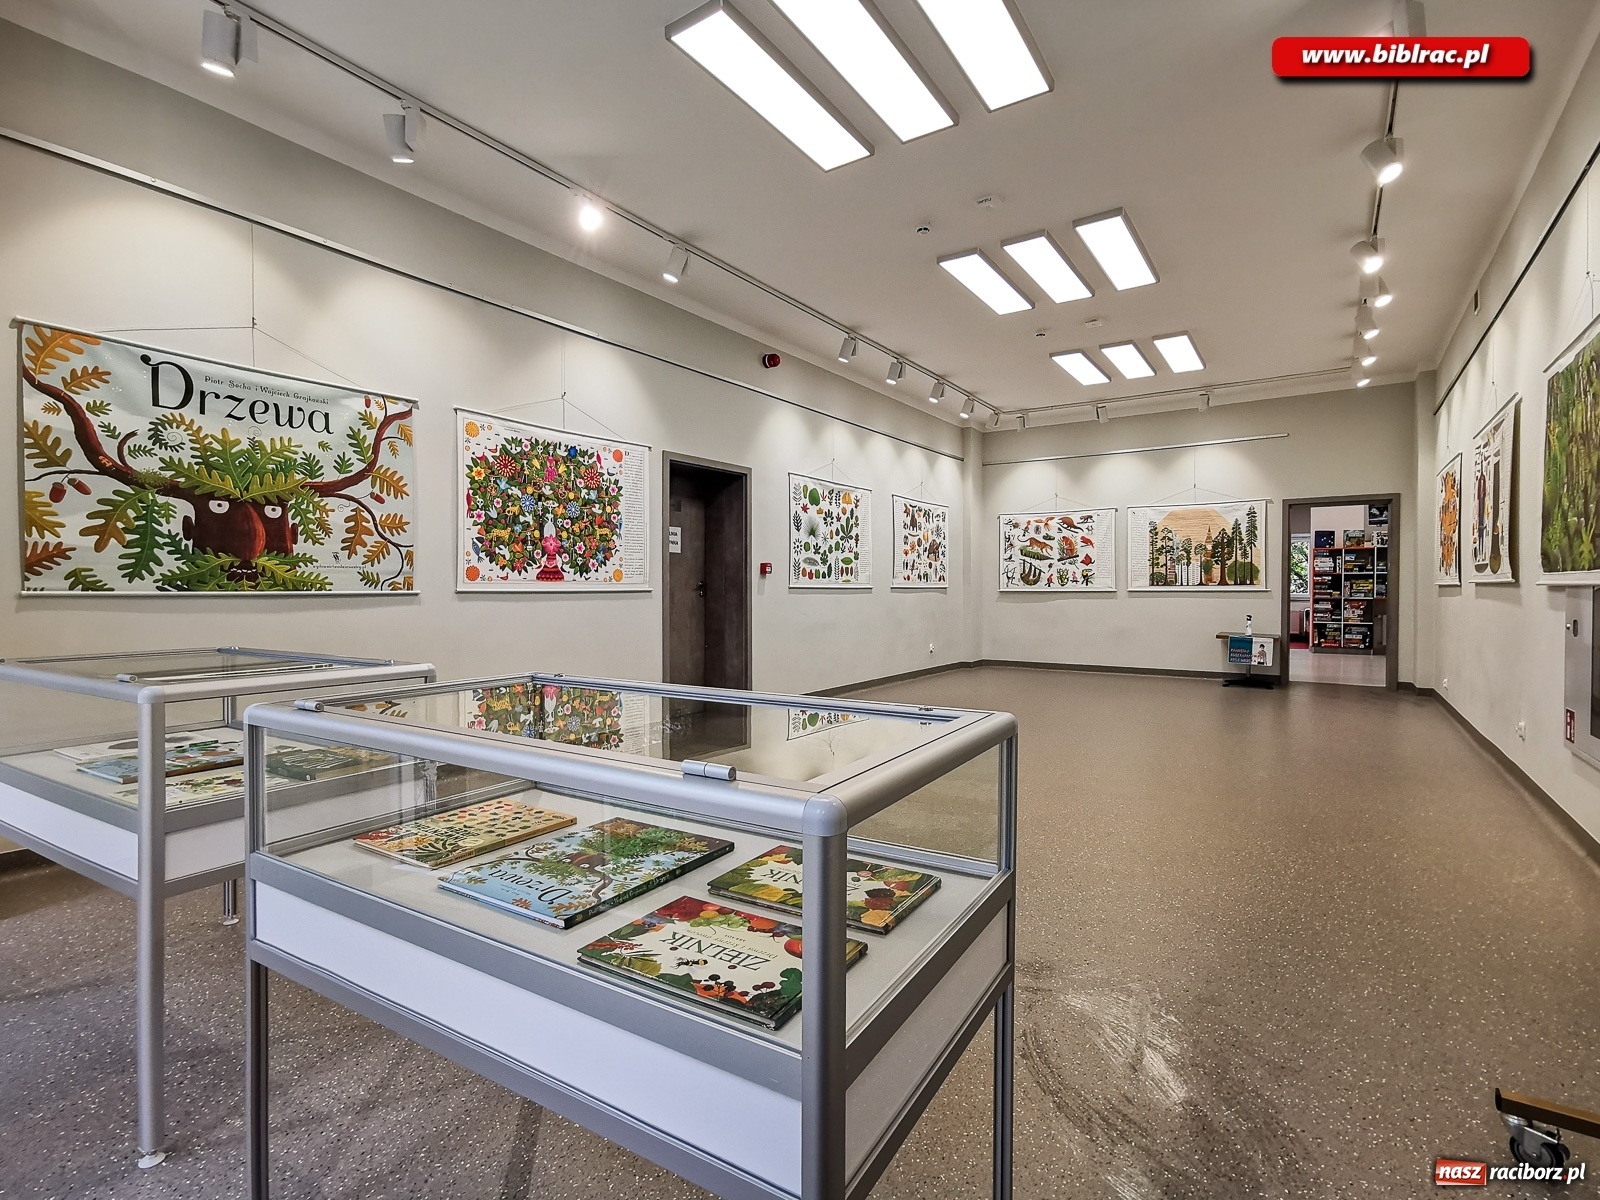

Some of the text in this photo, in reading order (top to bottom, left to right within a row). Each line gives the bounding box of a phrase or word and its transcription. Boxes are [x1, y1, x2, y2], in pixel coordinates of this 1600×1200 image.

[139, 353, 335, 435] Drzewa
[204, 375, 224, 386] Piotr
[228, 380, 252, 391] Socha
[260, 385, 290, 398] Wojciech
[293, 392, 329, 405] Grajkowski
[488, 869, 573, 904] Drzewa
[659, 931, 771, 971] ZIELNIK
